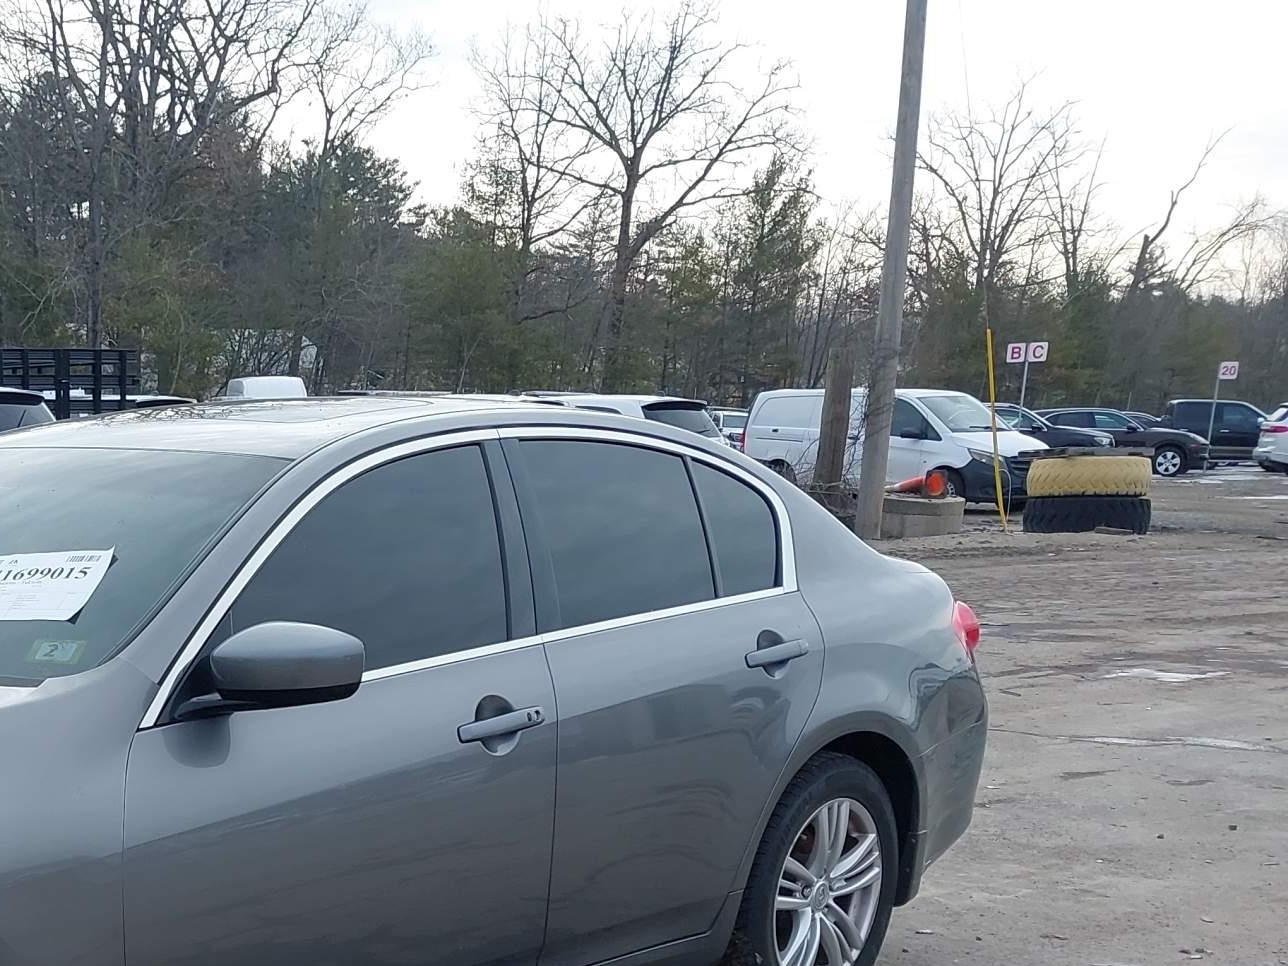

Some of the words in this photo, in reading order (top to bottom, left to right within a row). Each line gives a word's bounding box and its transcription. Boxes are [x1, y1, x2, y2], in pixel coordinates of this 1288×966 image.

[1010, 346, 1022, 360] B
[1033, 345, 1044, 359] C
[1222, 366, 1237, 376] 20
